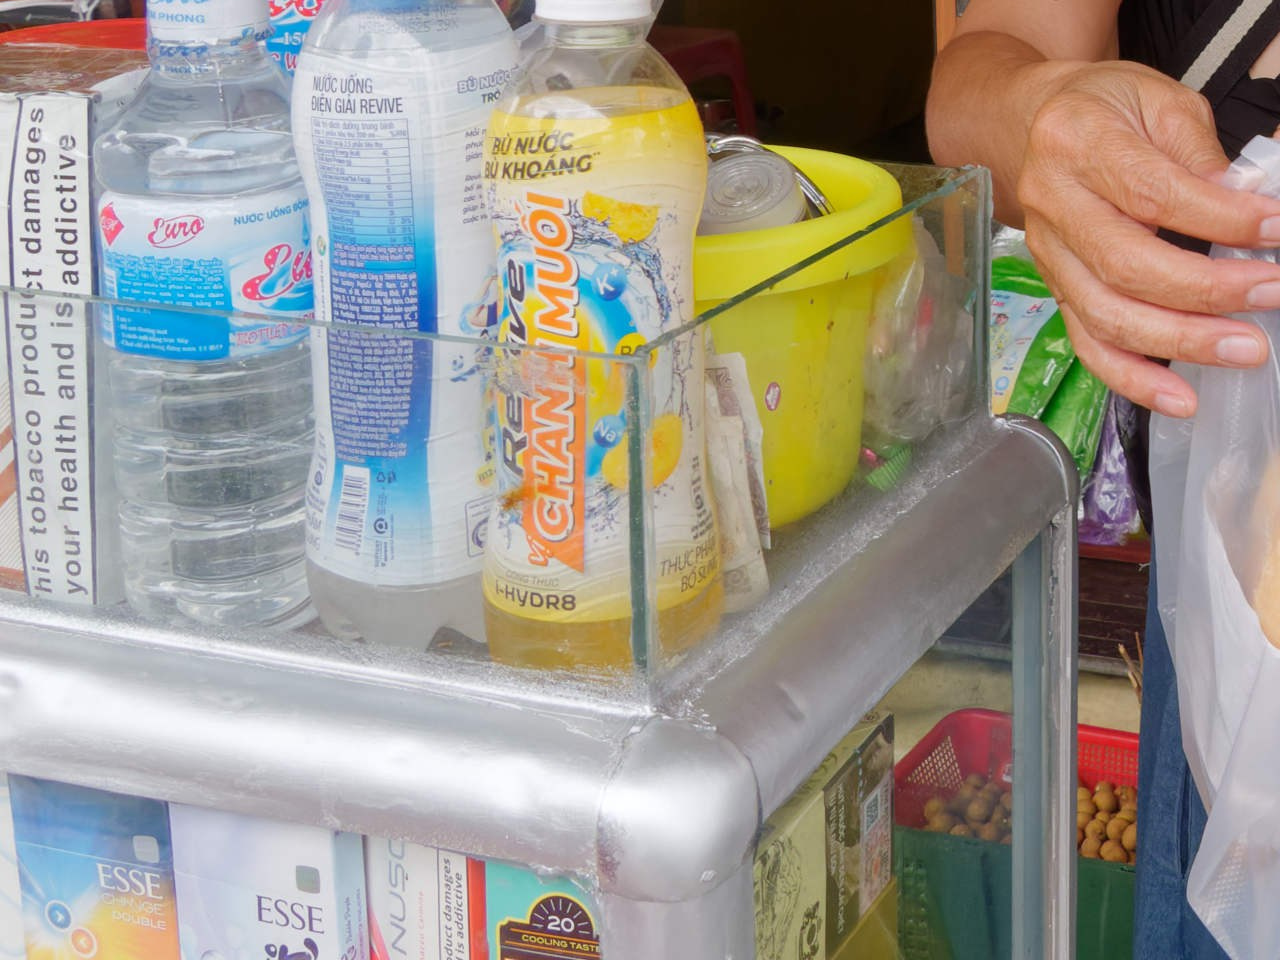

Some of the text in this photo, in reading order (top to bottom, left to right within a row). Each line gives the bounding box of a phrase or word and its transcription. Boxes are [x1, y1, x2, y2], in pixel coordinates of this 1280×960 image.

[158, 12, 205, 24] PHONG
[359, 97, 404, 114] REVIVE
[501, 154, 593, 180] KHOÁNG
[147, 215, 205, 247] Euro
[241, 243, 313, 302] Eu
[512, 190, 580, 338] MUỐI
[15, 106, 53, 598] his tobacco product damages
[50, 133, 89, 596] your health and is addictive
[96, 862, 164, 900] ESSE
[442, 857, 454, 922] damages
[112, 910, 167, 930] DOUBLE
[256, 894, 325, 935] ESSE
[454, 872, 464, 954] is addictive
[546, 915, 575, 932] 20
[521, 934, 568, 949] COOLING
